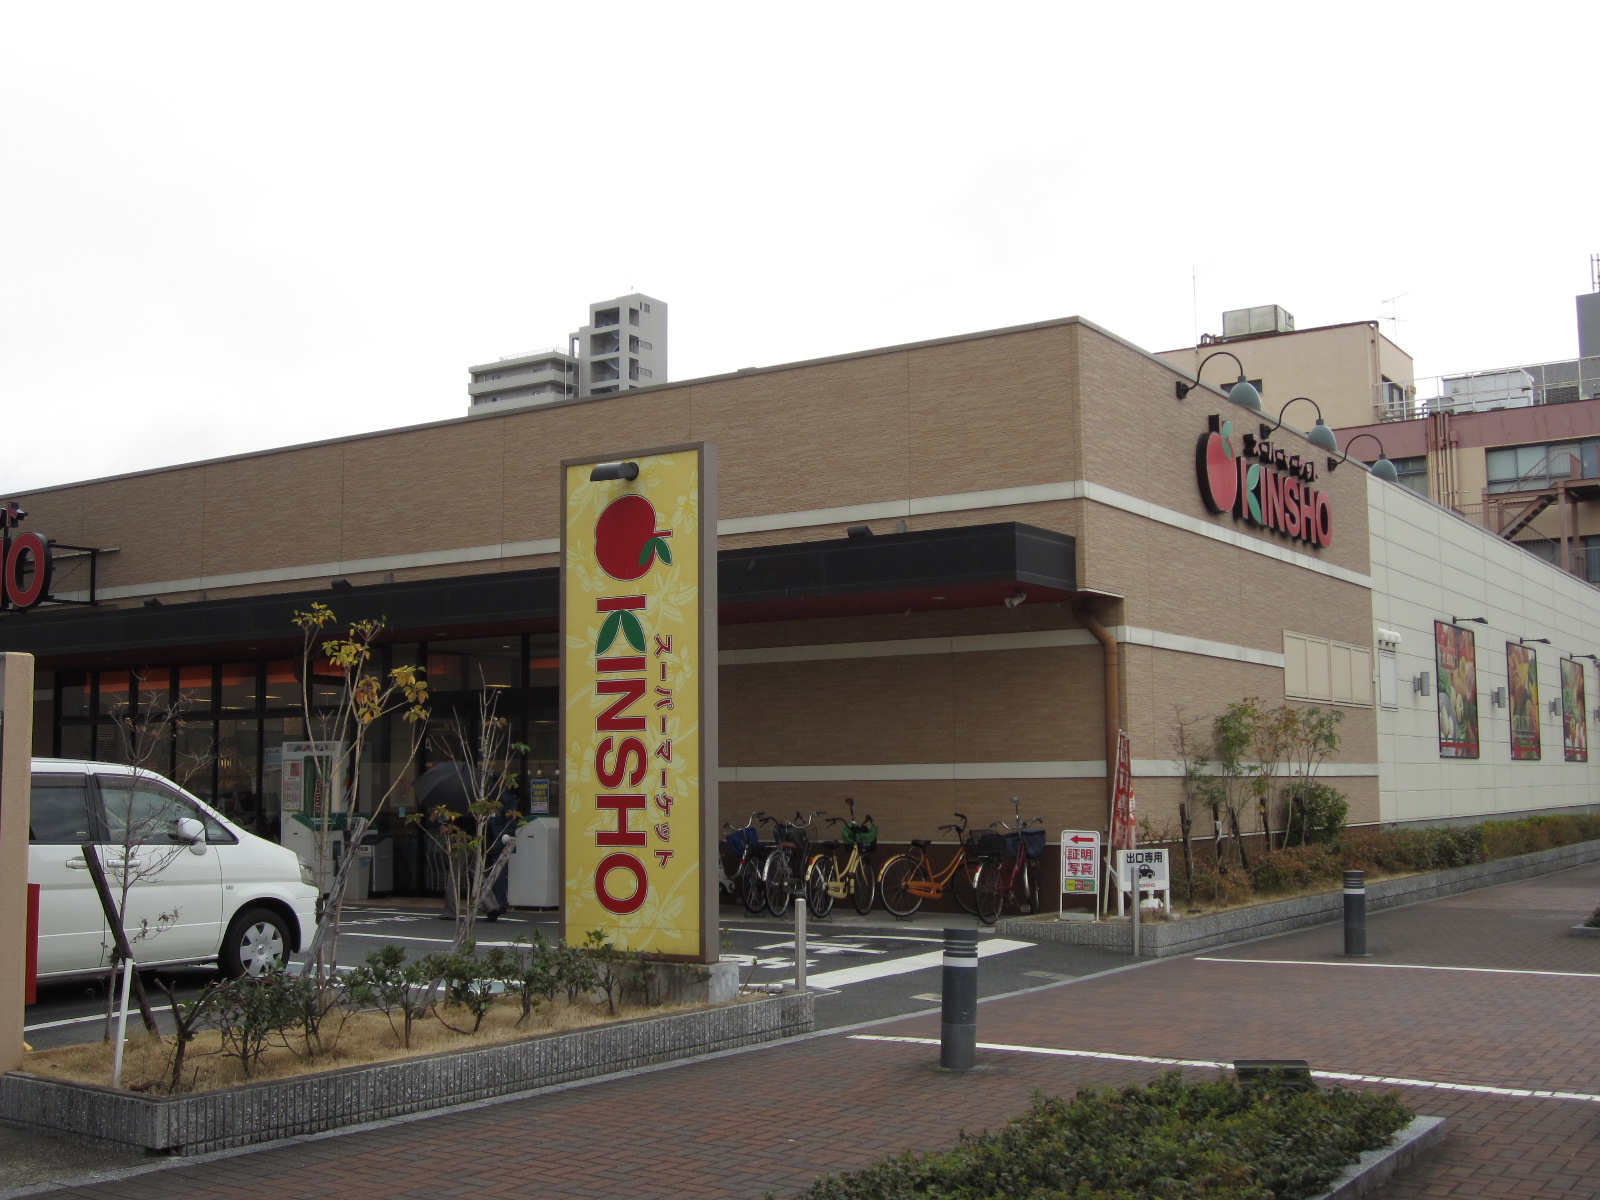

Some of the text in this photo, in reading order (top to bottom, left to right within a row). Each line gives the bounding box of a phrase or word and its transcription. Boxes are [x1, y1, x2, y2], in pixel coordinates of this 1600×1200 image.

[1234, 455, 1333, 548] KINSHO
[594, 594, 649, 916] KINSHO
[653, 633, 675, 868] スーパーマーケット
[1067, 848, 1094, 861] 証明
[1067, 862, 1094, 875] 写真
[1126, 851, 1163, 864] 出口専用
